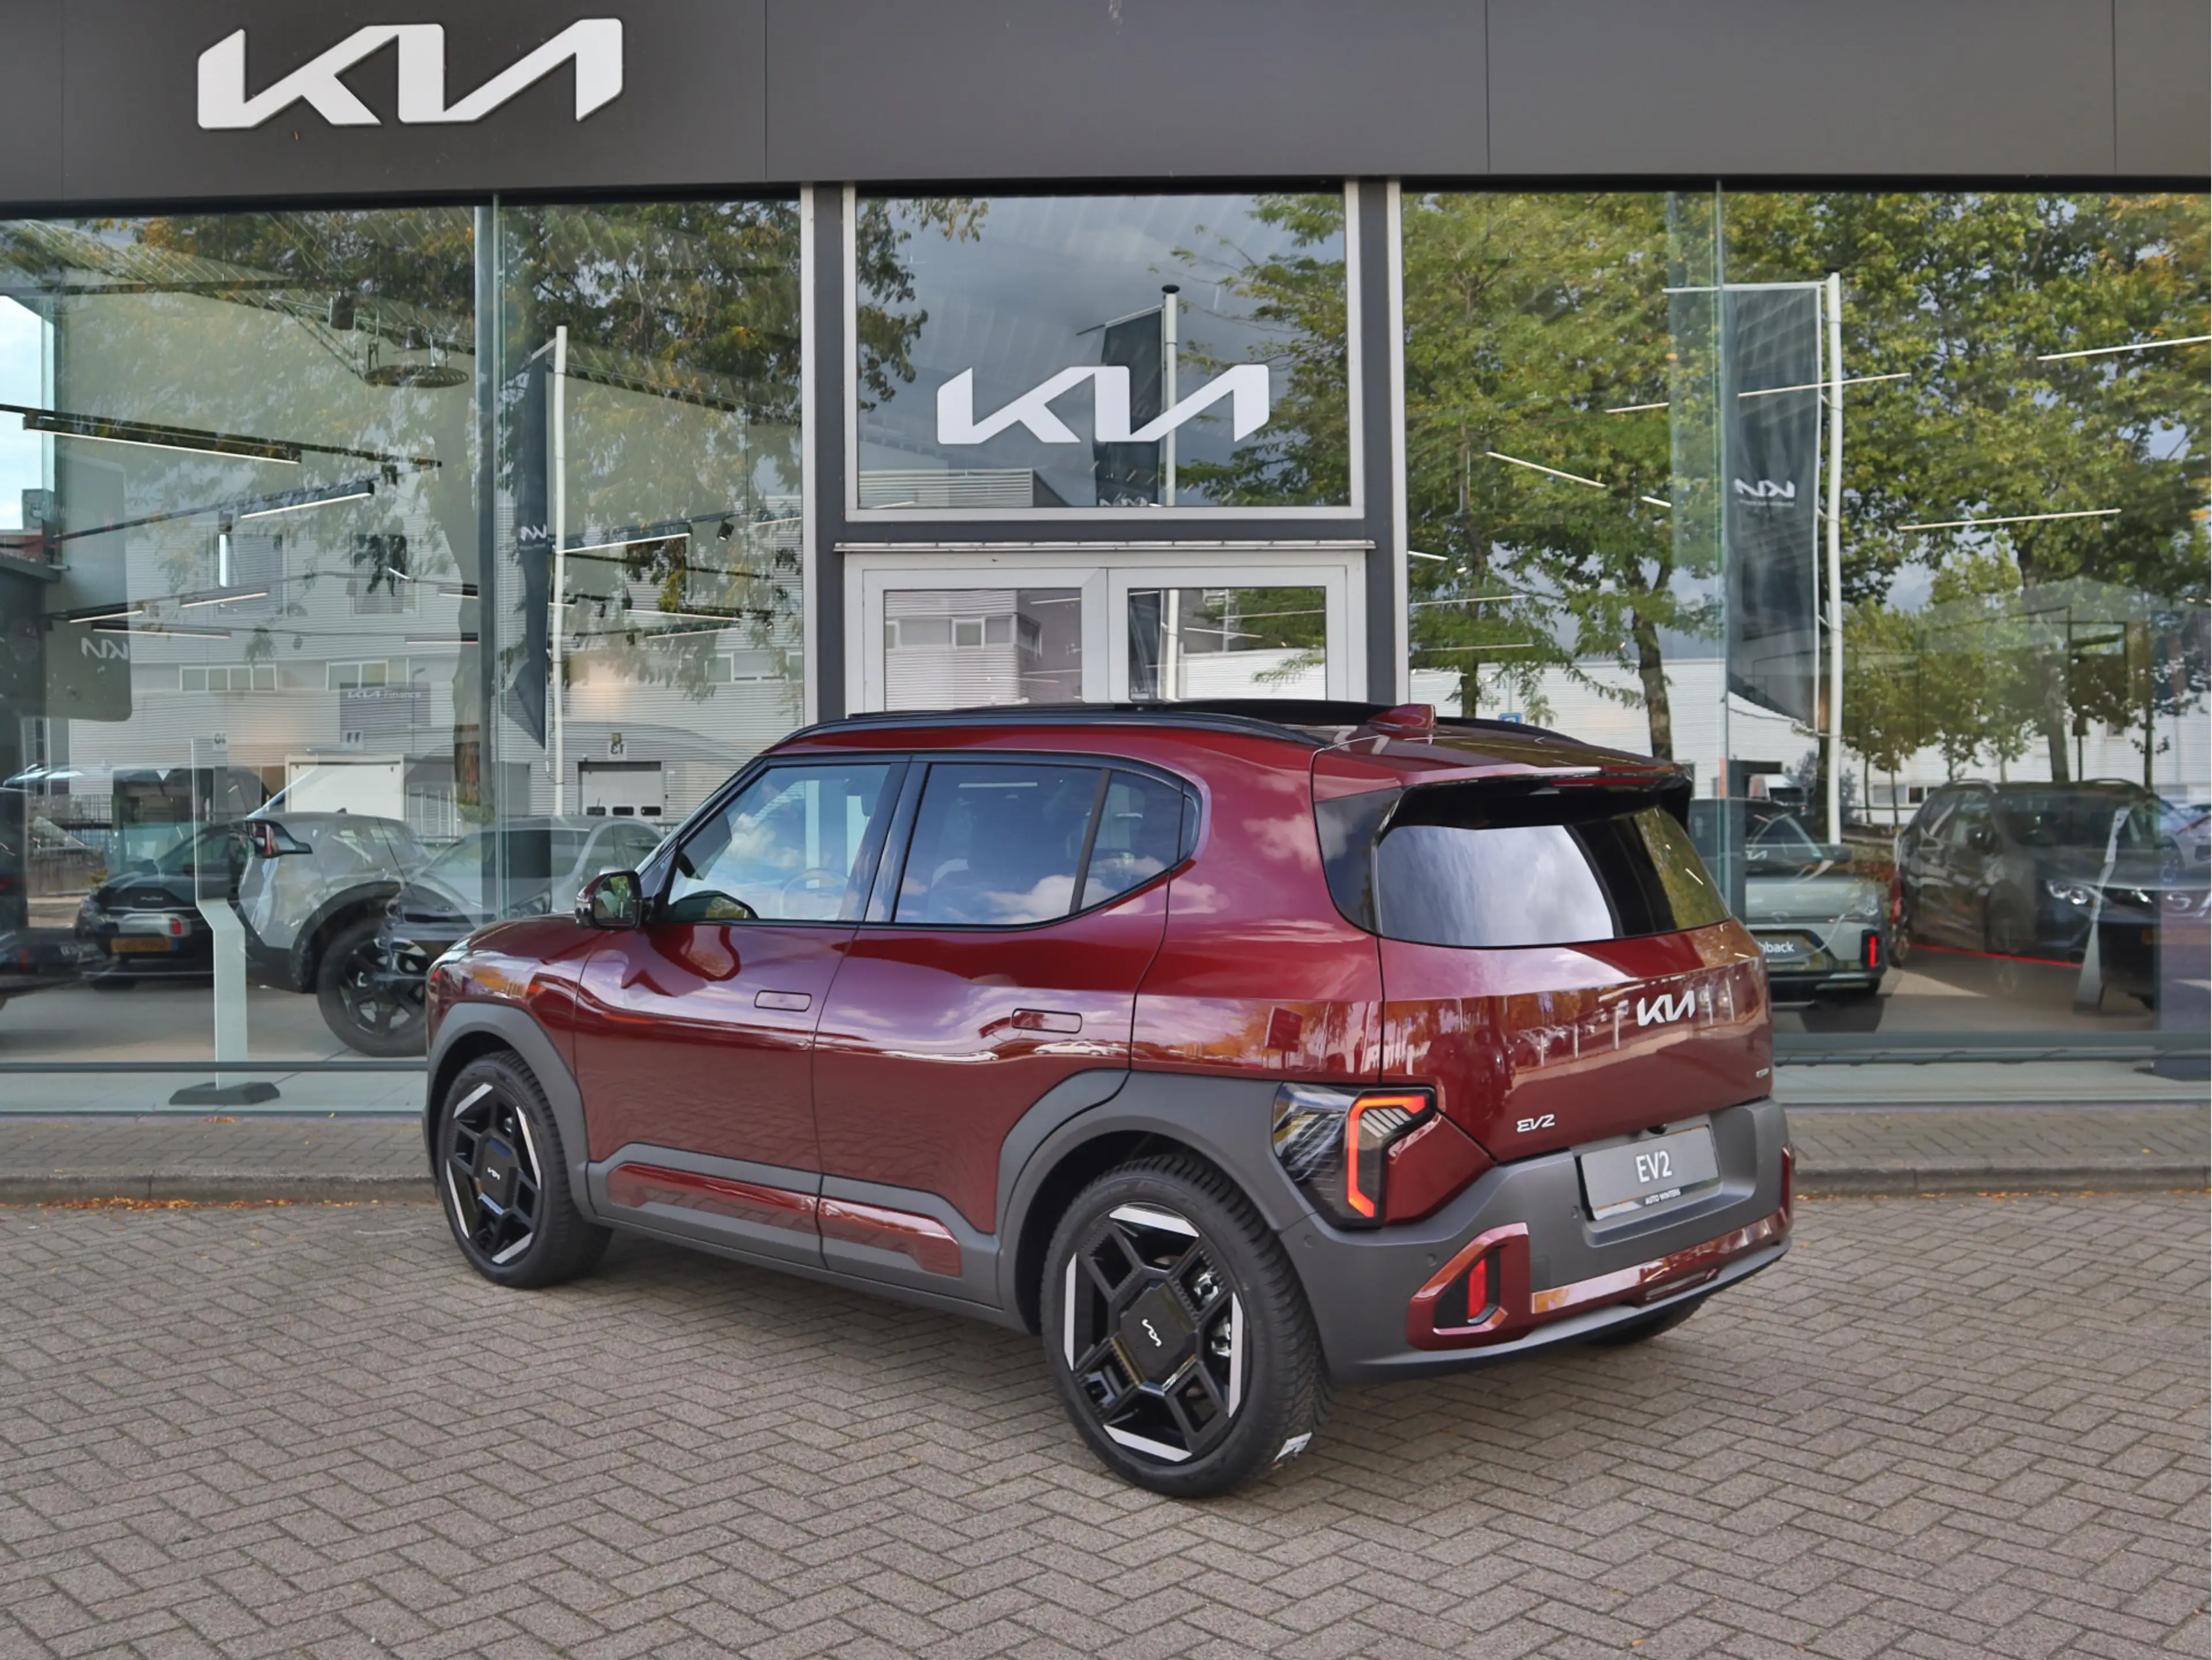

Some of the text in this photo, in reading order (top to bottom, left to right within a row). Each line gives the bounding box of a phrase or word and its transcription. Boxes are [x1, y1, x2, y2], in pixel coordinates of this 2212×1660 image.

[198, 18, 623, 129] KIA
[937, 364, 1269, 444] KIA
[1637, 990, 1695, 1026] KIA
[1517, 1114, 1555, 1133] EV2
[1636, 1150, 1672, 1183] EV2
